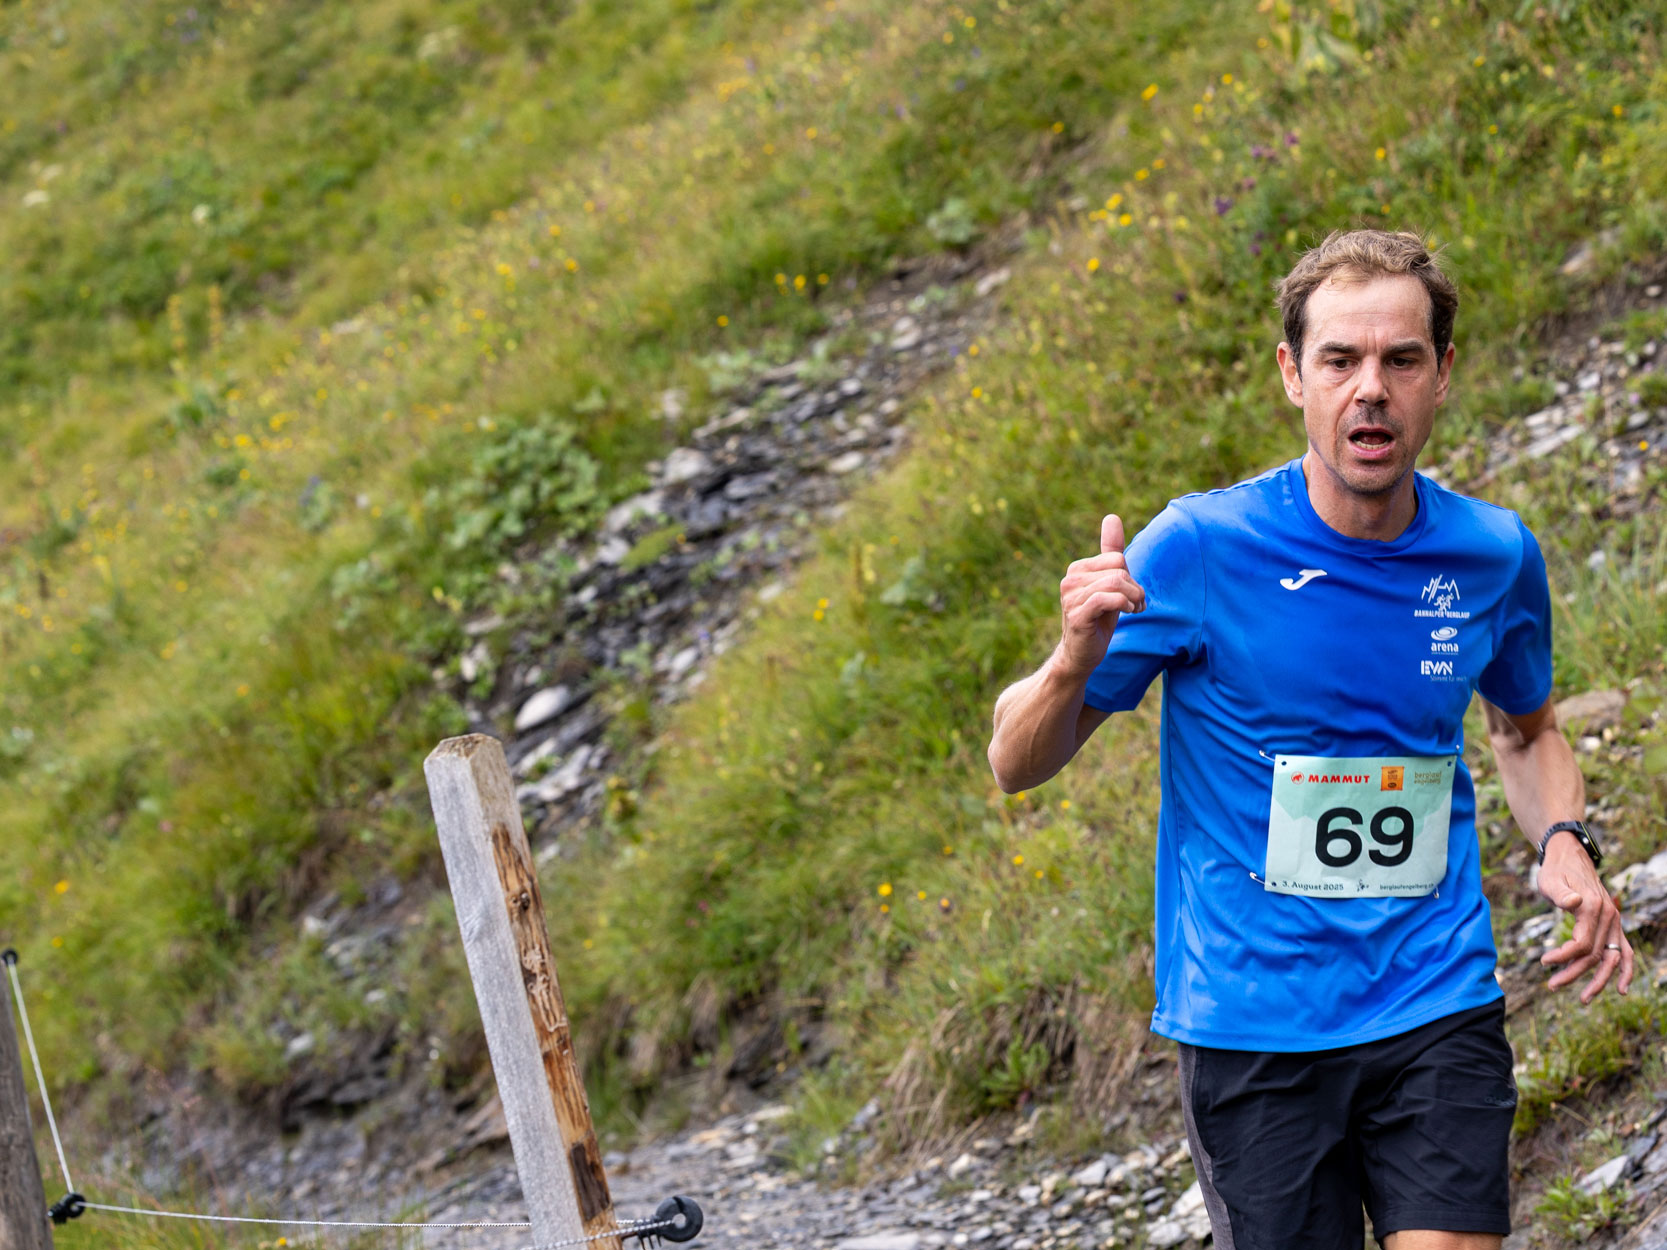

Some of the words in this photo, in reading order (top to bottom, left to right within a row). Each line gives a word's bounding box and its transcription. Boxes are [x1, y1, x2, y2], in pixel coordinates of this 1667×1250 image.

[1430, 642, 1459, 652] arena
[1308, 774, 1370, 784] MAMMUT
[1315, 806, 1414, 868] 69
[1282, 880, 1290, 888] 3.
[1291, 881, 1322, 891] August
[1323, 883, 1344, 891] 2025
